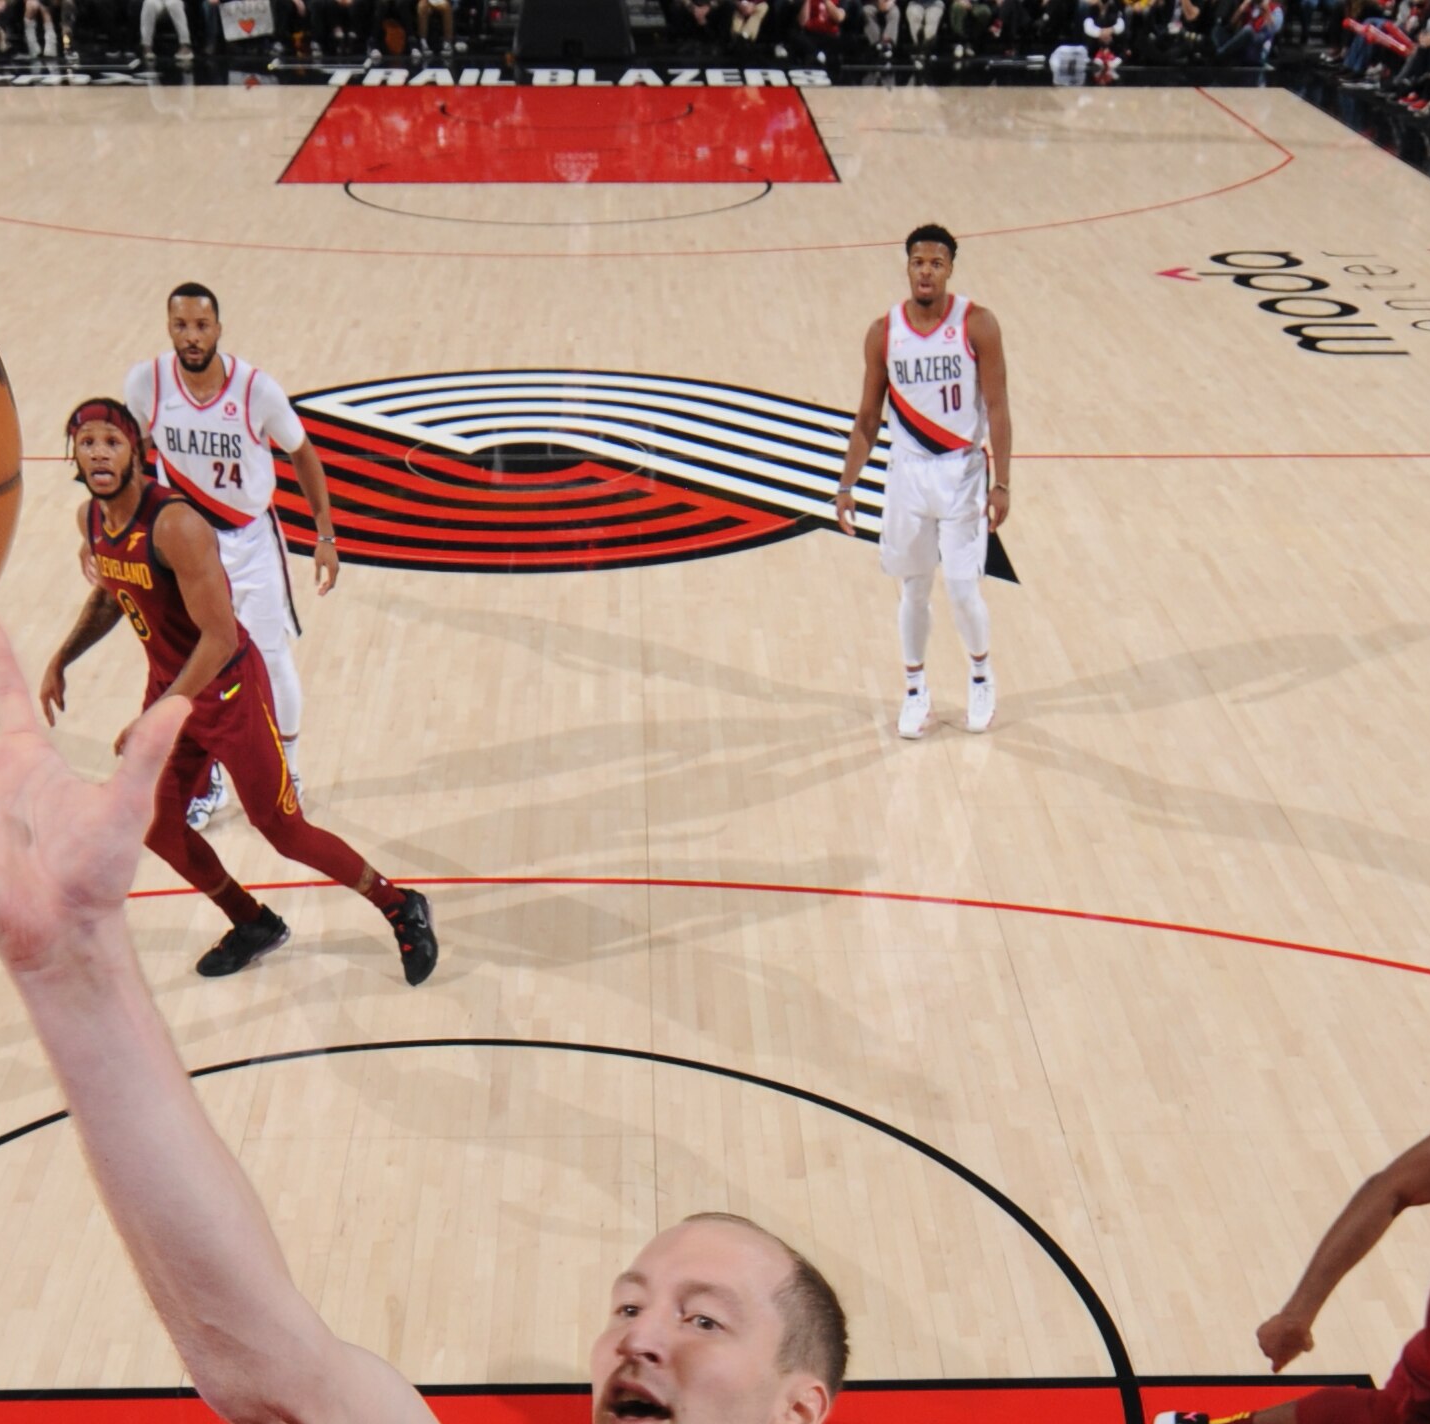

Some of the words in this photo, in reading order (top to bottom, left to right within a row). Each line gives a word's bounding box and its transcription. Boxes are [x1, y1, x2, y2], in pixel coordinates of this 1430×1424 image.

[322, 68, 516, 86] TRAIL
[526, 68, 832, 86] BLAZERS
[1197, 250, 1410, 355] moda
[893, 354, 962, 385] BLAZERS
[939, 383, 961, 413] 10
[165, 425, 243, 460] BLAZERS
[212, 461, 243, 489] 24
[116, 588, 152, 641] 8
